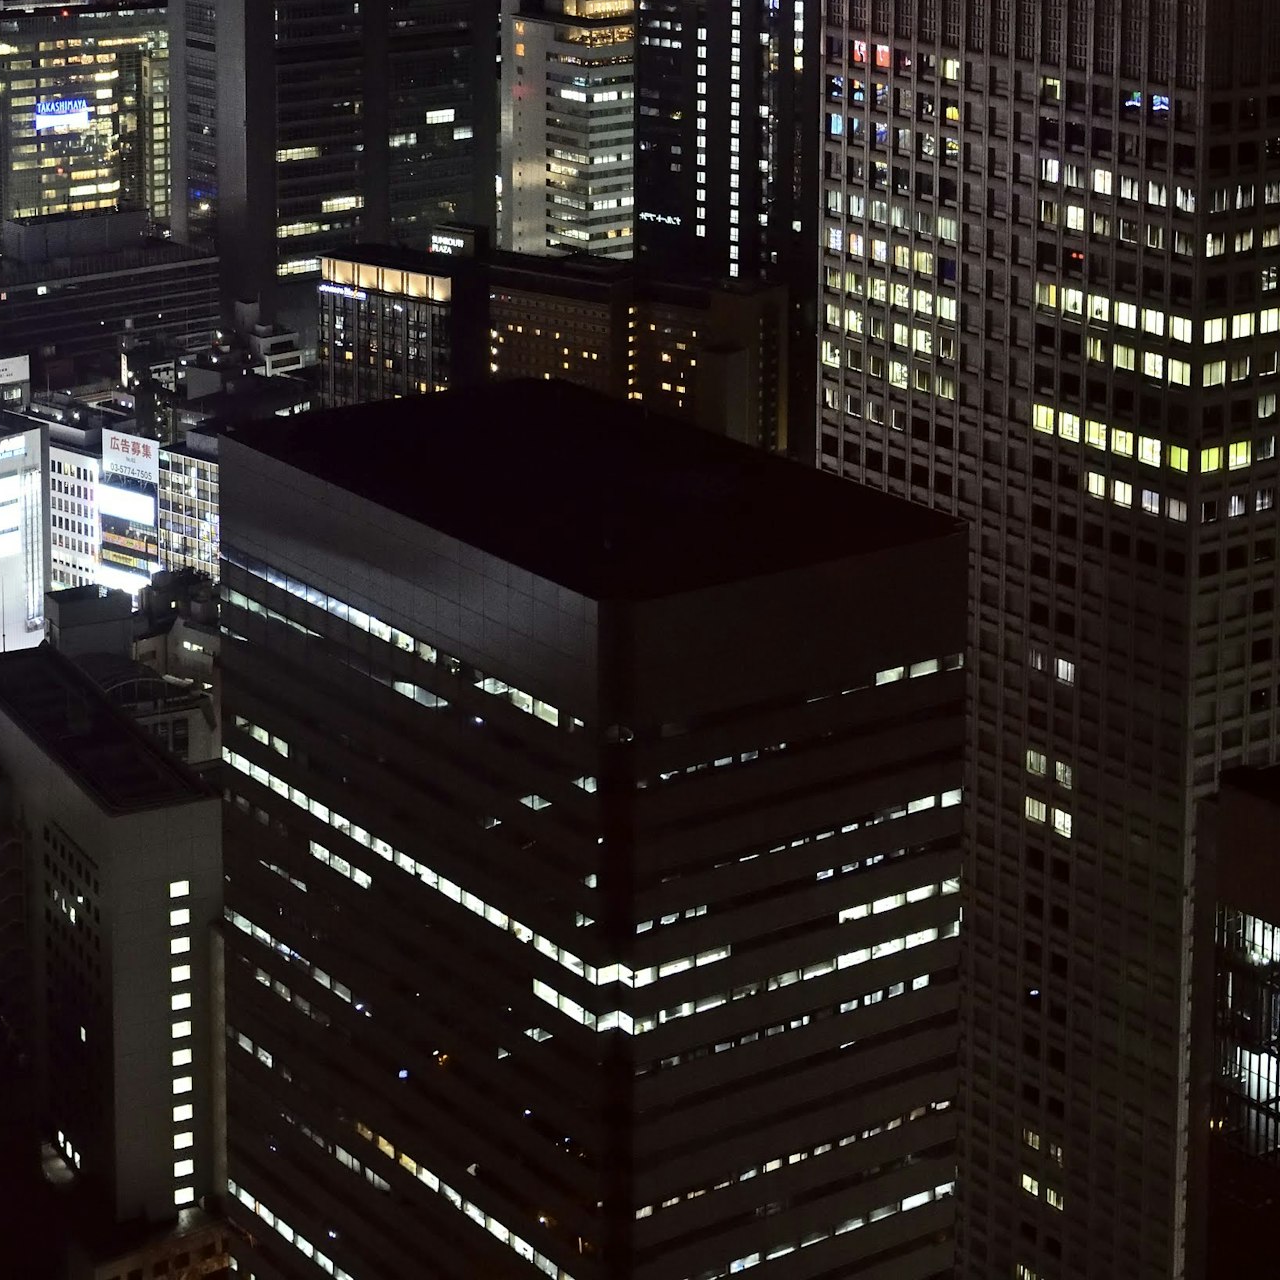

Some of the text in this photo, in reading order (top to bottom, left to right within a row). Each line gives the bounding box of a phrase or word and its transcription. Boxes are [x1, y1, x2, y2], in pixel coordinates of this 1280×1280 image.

[36, 99, 87, 113] TAKASHIMAYA
[431, 243, 452, 255] PLAZA
[110, 436, 153, 460] 広告募集
[110, 462, 153, 481] 03-5774-7505
